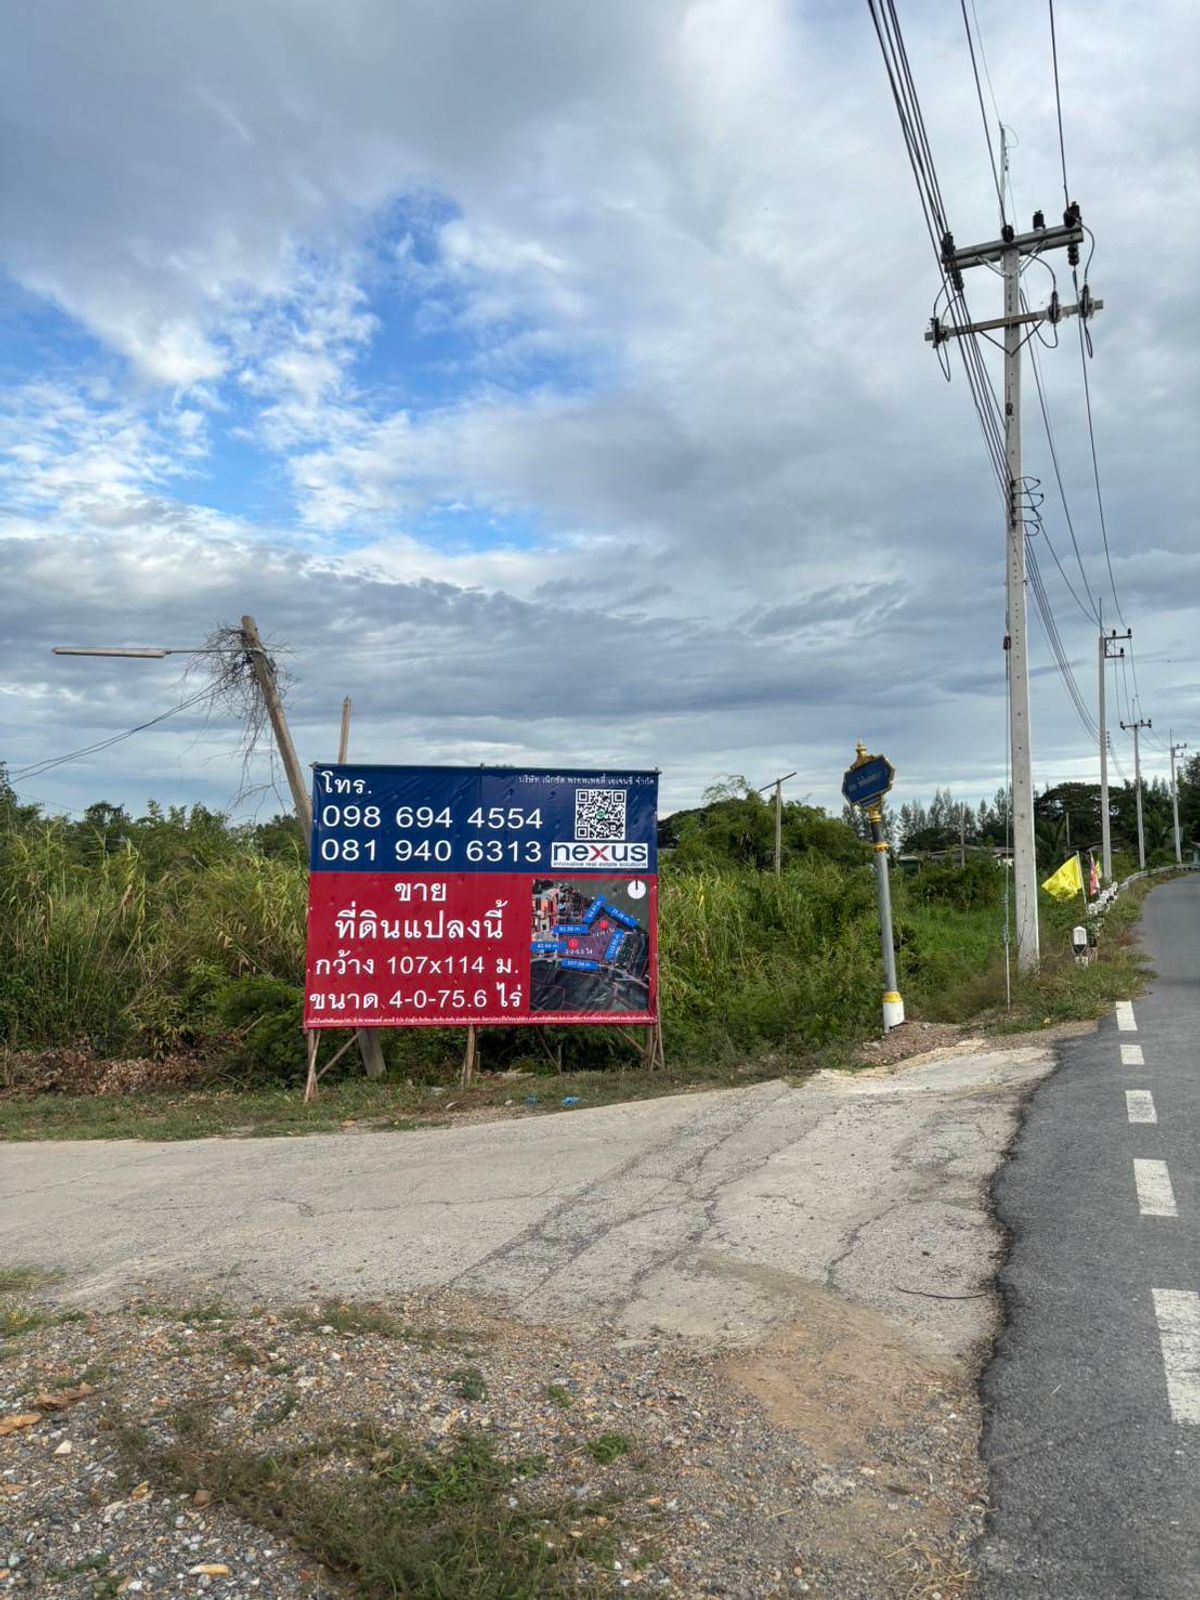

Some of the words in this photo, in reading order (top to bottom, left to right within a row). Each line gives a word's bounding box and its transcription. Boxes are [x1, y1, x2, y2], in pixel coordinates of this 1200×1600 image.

[321, 771, 372, 795] โทร.
[322, 804, 382, 828] 098
[395, 806, 454, 829] 694
[466, 806, 543, 829] 4554
[321, 838, 376, 861] 081
[394, 839, 452, 862] 940
[465, 839, 542, 863] 6313
[553, 844, 647, 862] nexus
[394, 881, 447, 902] ขาย
[334, 899, 508, 939] ที่ดินแปลงนี้
[315, 949, 374, 975] กว้าง
[387, 955, 485, 974] 107x114
[496, 958, 519, 974] ม.
[309, 991, 379, 1010] ขนาด
[388, 989, 487, 1009] 4-0-75.6
[496, 982, 523, 1008] ไร่
